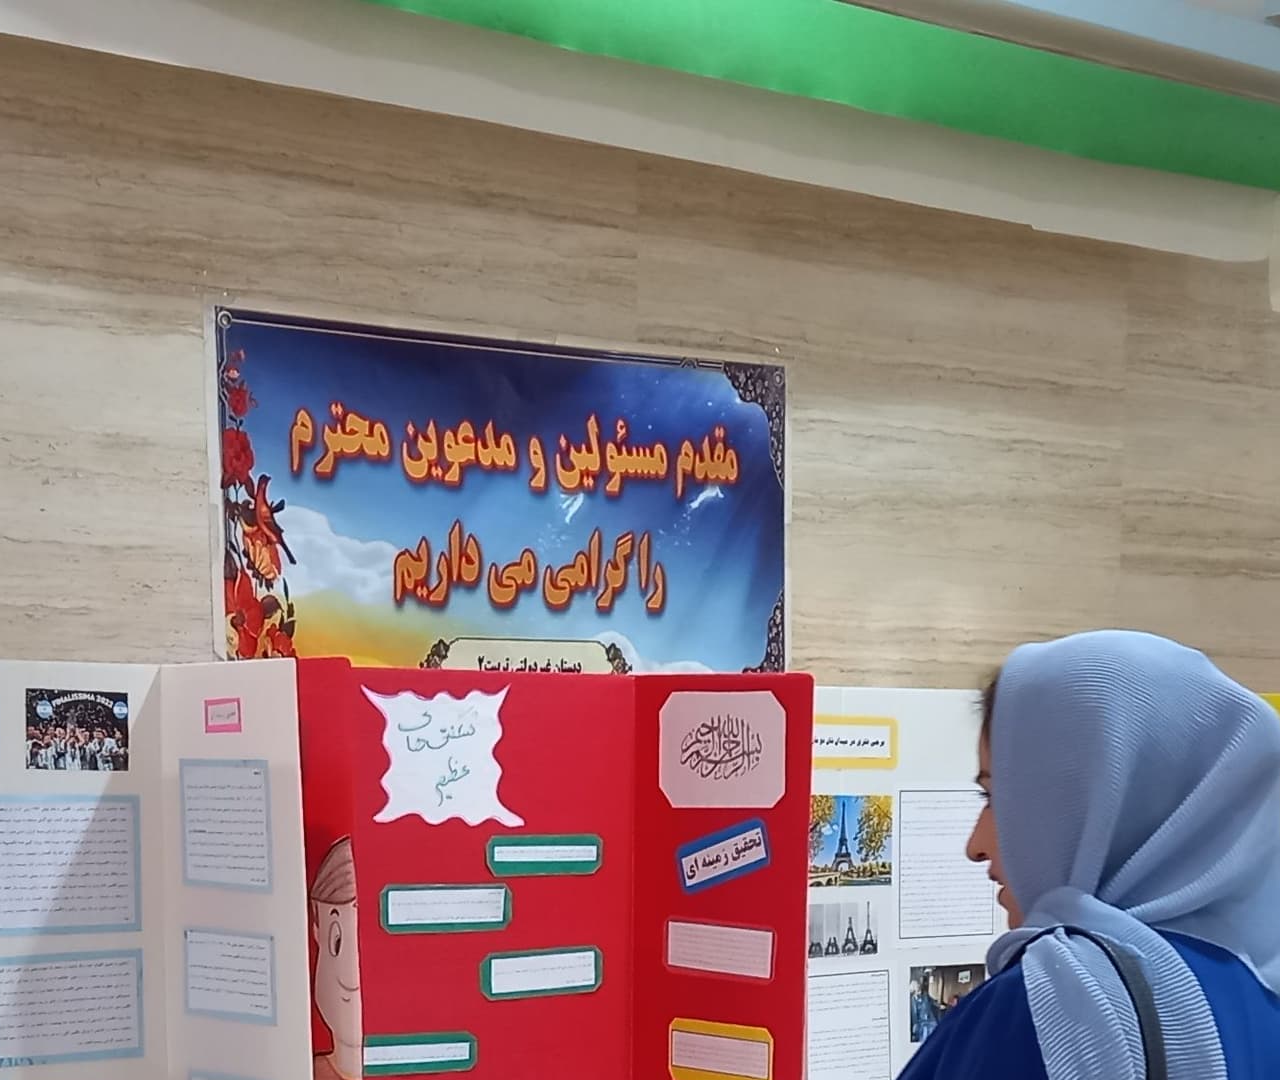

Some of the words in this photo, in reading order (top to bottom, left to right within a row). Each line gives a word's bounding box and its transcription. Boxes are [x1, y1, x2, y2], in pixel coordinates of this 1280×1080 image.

[289, 399, 392, 475] محترم
[401, 417, 518, 484] مدعوین
[528, 435, 548, 490] و
[554, 412, 670, 494] مسئولین
[675, 424, 740, 500] مقدم
[392, 517, 482, 605] داریم
[486, 547, 538, 607] می
[541, 526, 636, 609] گرامی
[637, 530, 666, 610] را
[435, 756, 471, 807] عظیم
[685, 856, 700, 880] ای
[701, 848, 729, 870] زمینه
[731, 831, 762, 862] تحقیق
